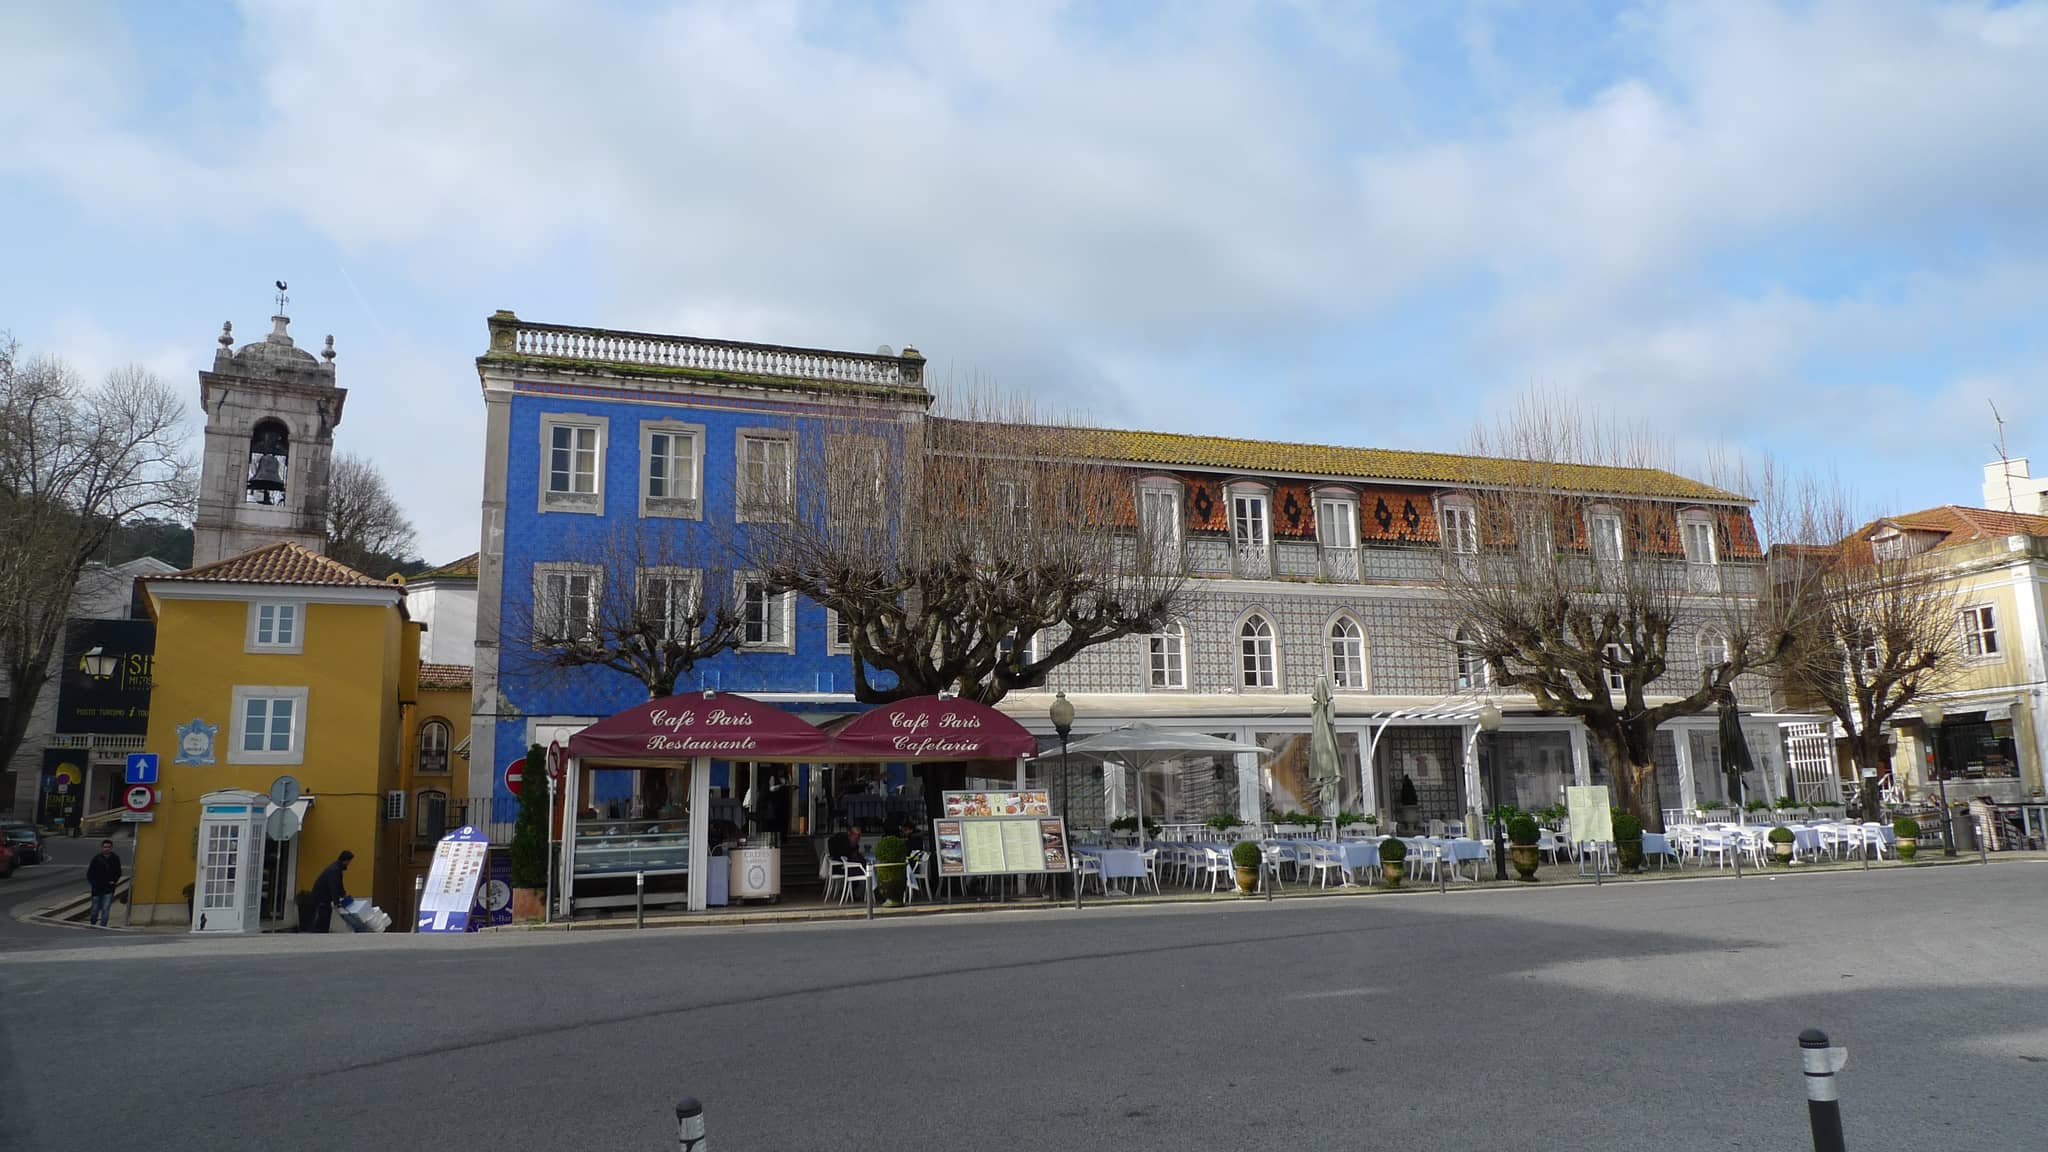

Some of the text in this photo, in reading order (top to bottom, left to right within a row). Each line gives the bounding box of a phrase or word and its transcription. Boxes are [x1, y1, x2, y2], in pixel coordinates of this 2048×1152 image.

[650, 709, 753, 733] Café Paris
[890, 712, 981, 734] Café Paris
[646, 735, 757, 750] Restaurante
[893, 736, 979, 756] Cafetaria
